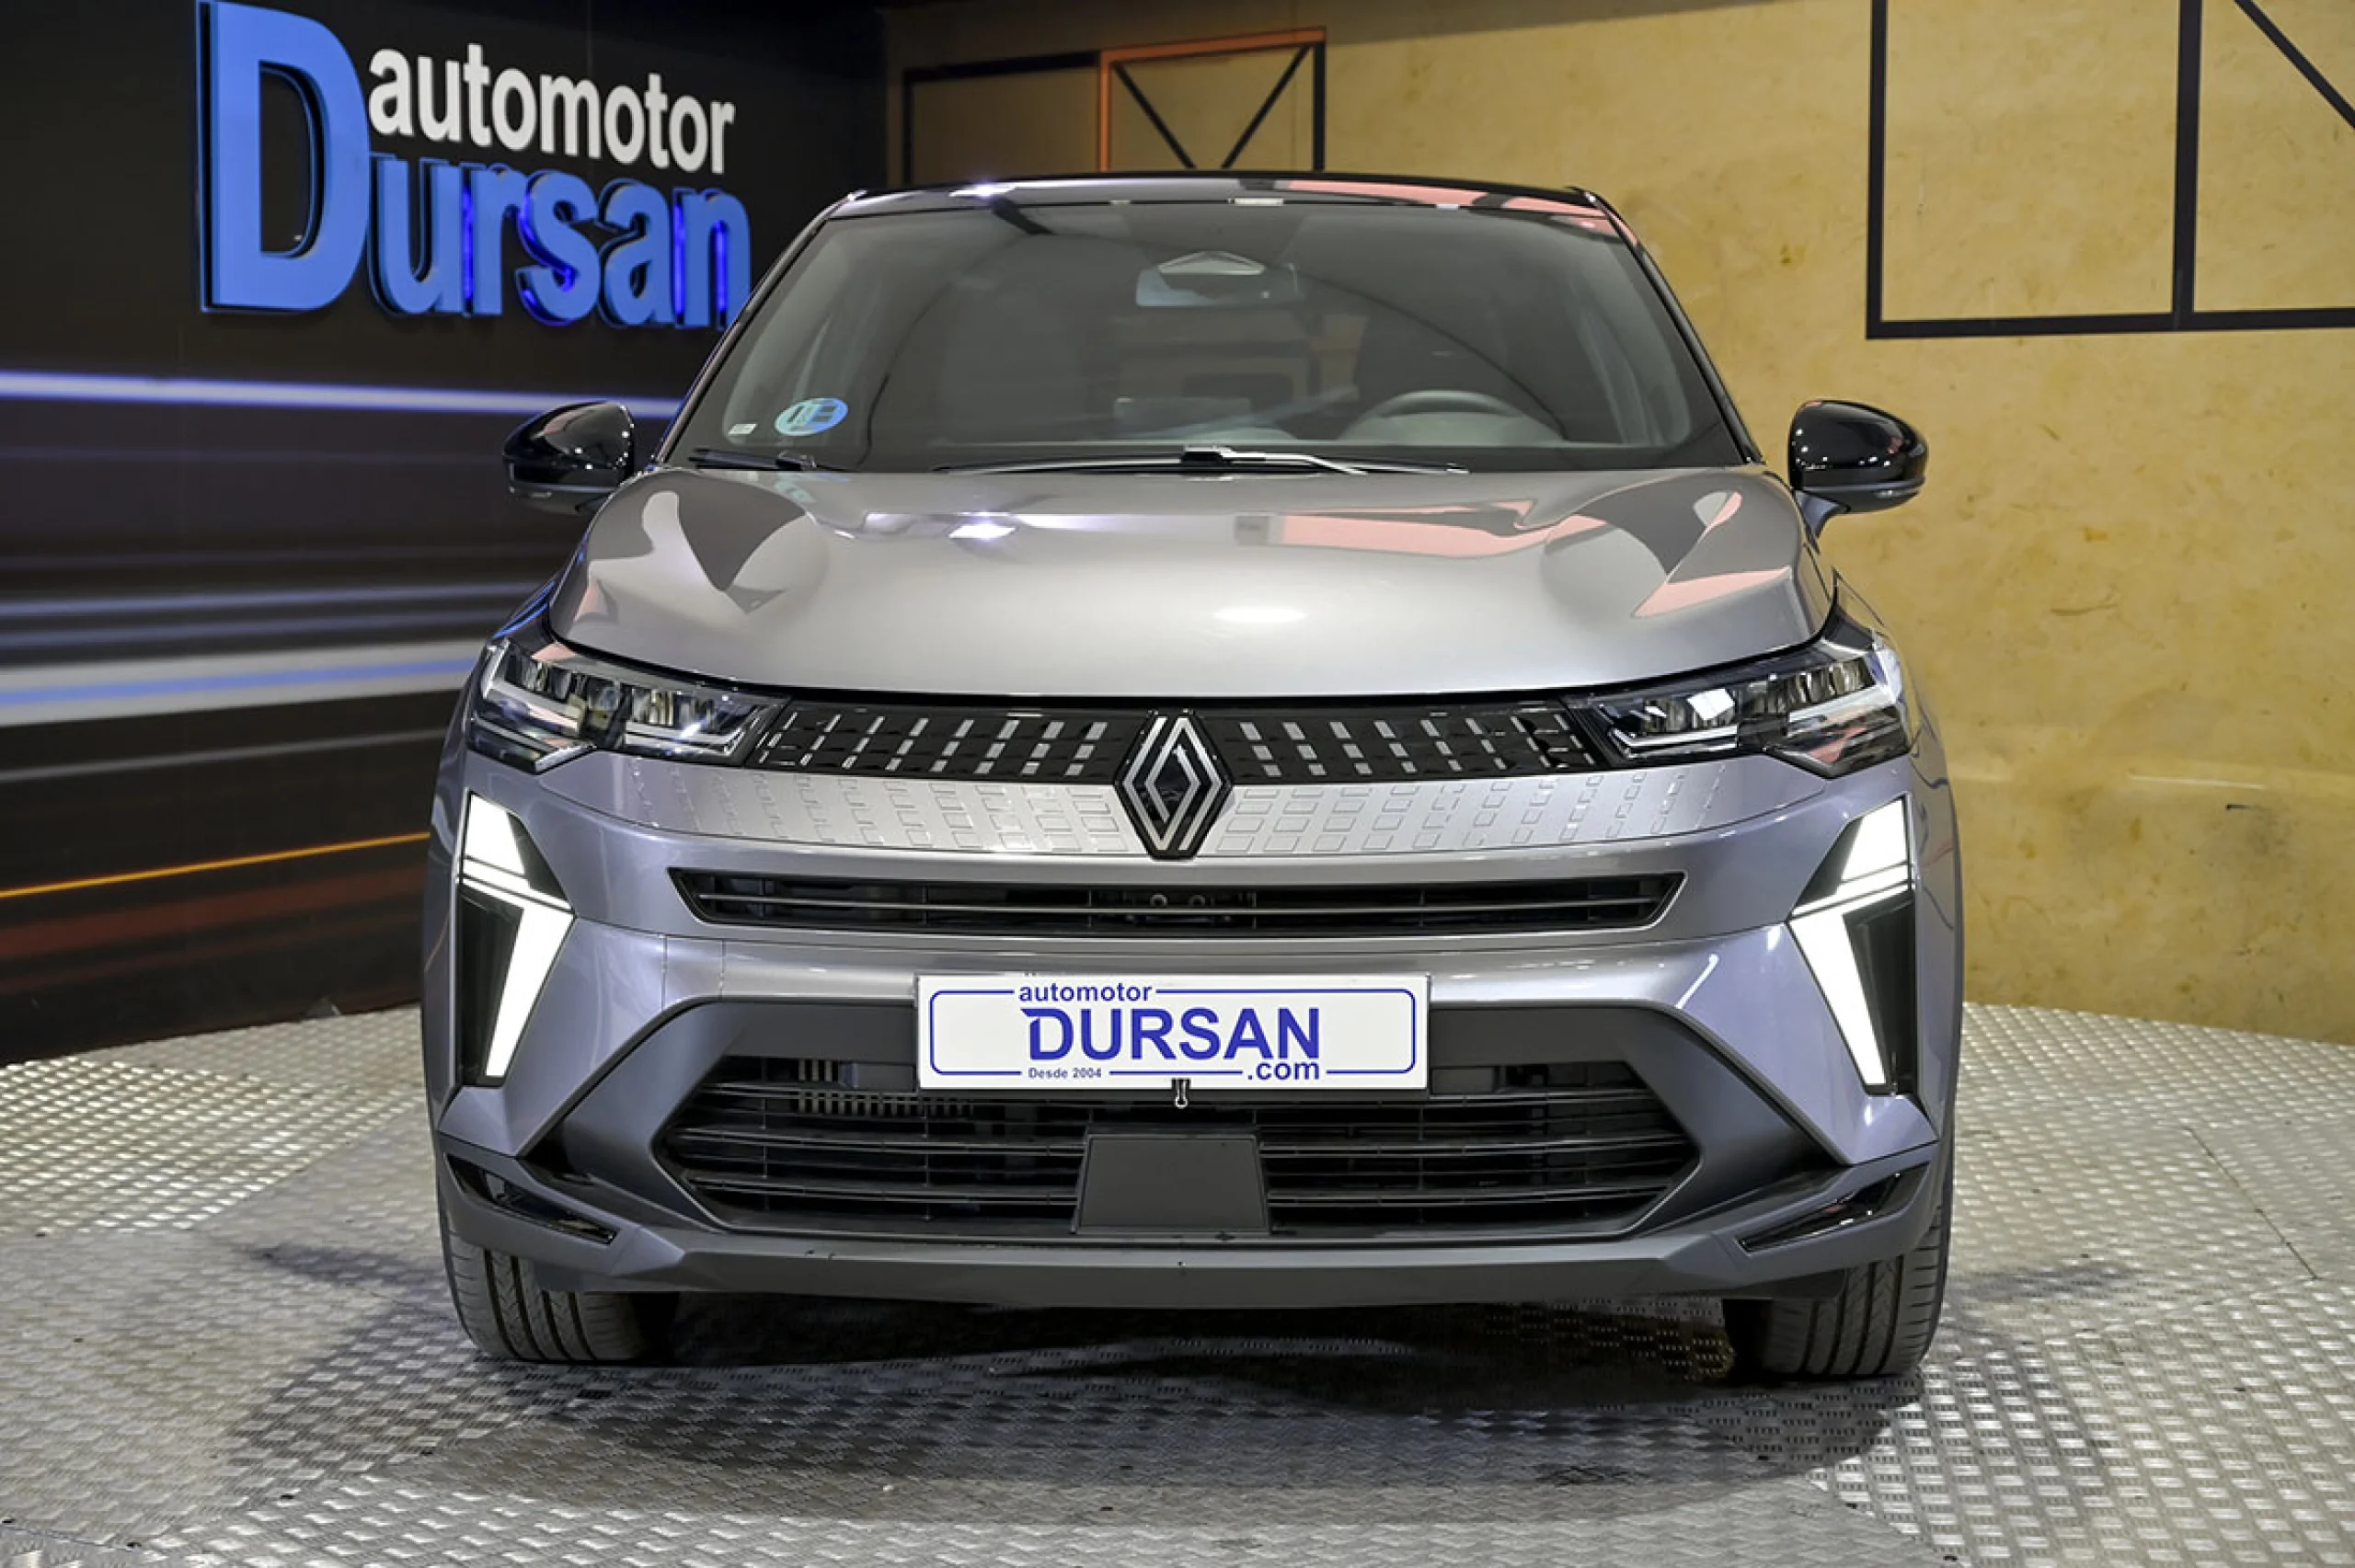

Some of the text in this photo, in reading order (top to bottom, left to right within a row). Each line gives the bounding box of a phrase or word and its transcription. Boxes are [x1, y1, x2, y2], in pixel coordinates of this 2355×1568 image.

[369, 43, 735, 175] automotor
[197, 0, 751, 328] Dursan
[1019, 982, 1153, 1001] automotor
[1020, 1007, 1319, 1060] DURSAN
[1028, 1067, 1102, 1079] Desde 2004
[1247, 1061, 1320, 1081] .com
